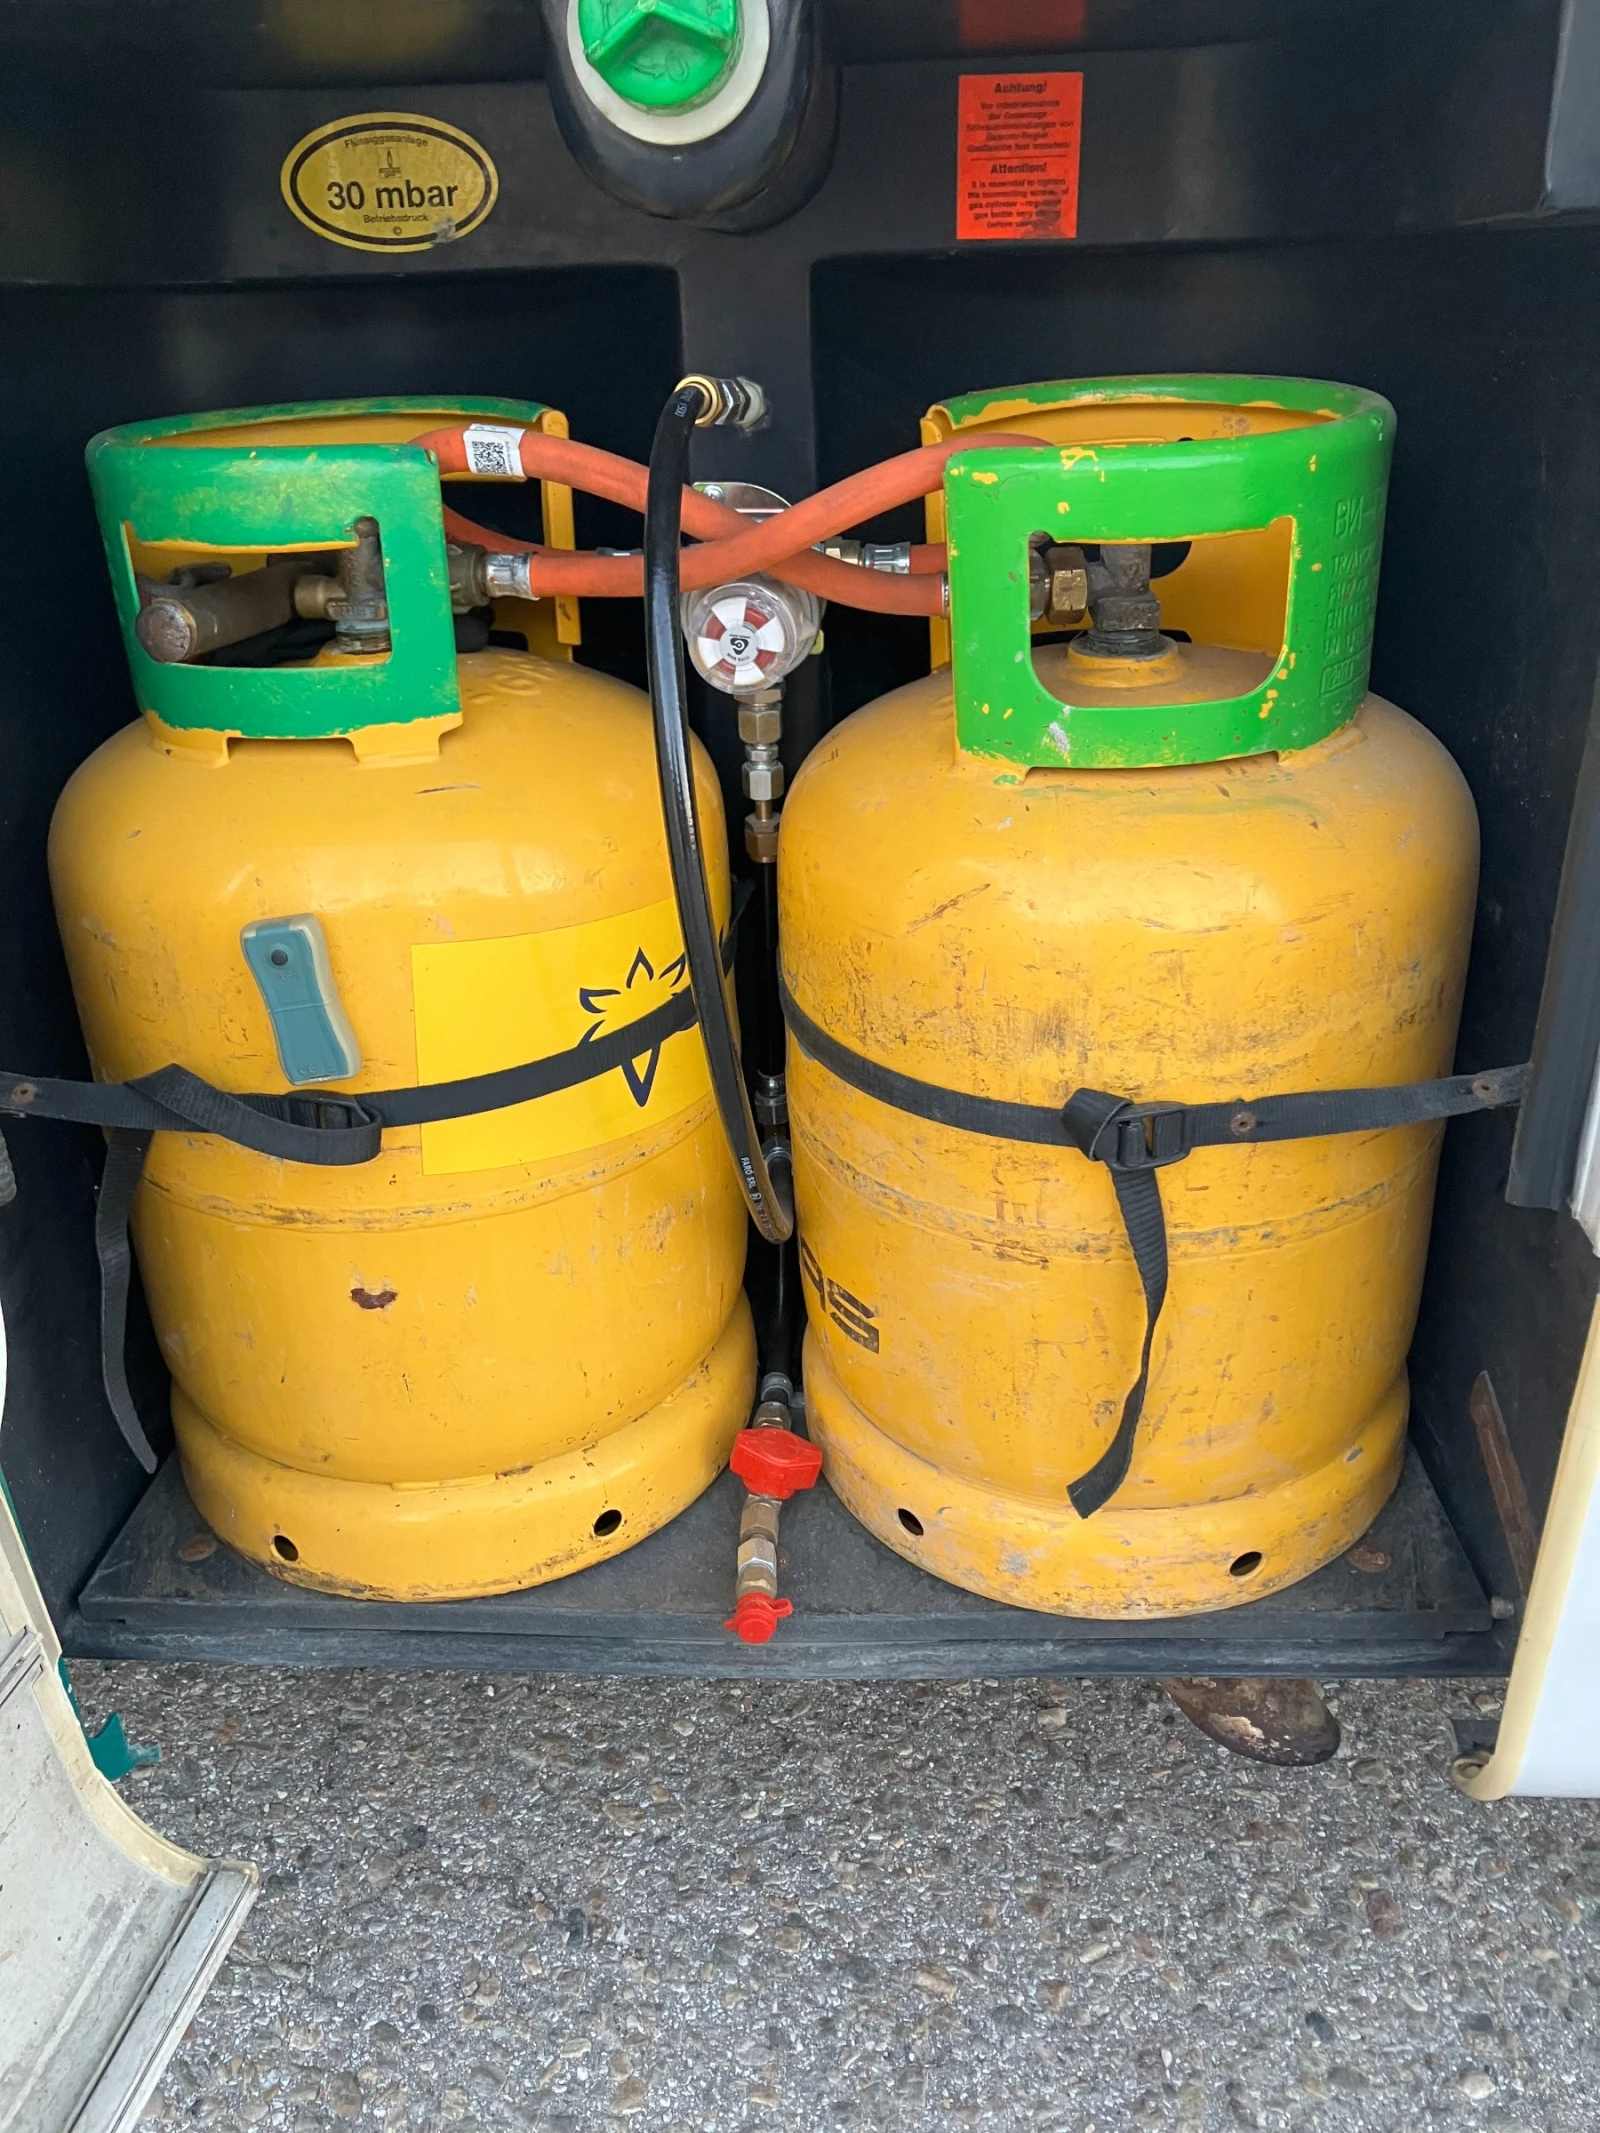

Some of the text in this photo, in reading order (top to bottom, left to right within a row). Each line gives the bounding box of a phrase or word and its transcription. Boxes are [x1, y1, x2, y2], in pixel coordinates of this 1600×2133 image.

[994, 82, 1047, 94] Achtung!
[991, 162, 1047, 173] Attention!
[326, 179, 458, 210] 30 mbar
[363, 213, 429, 224] Betriebsdruck
